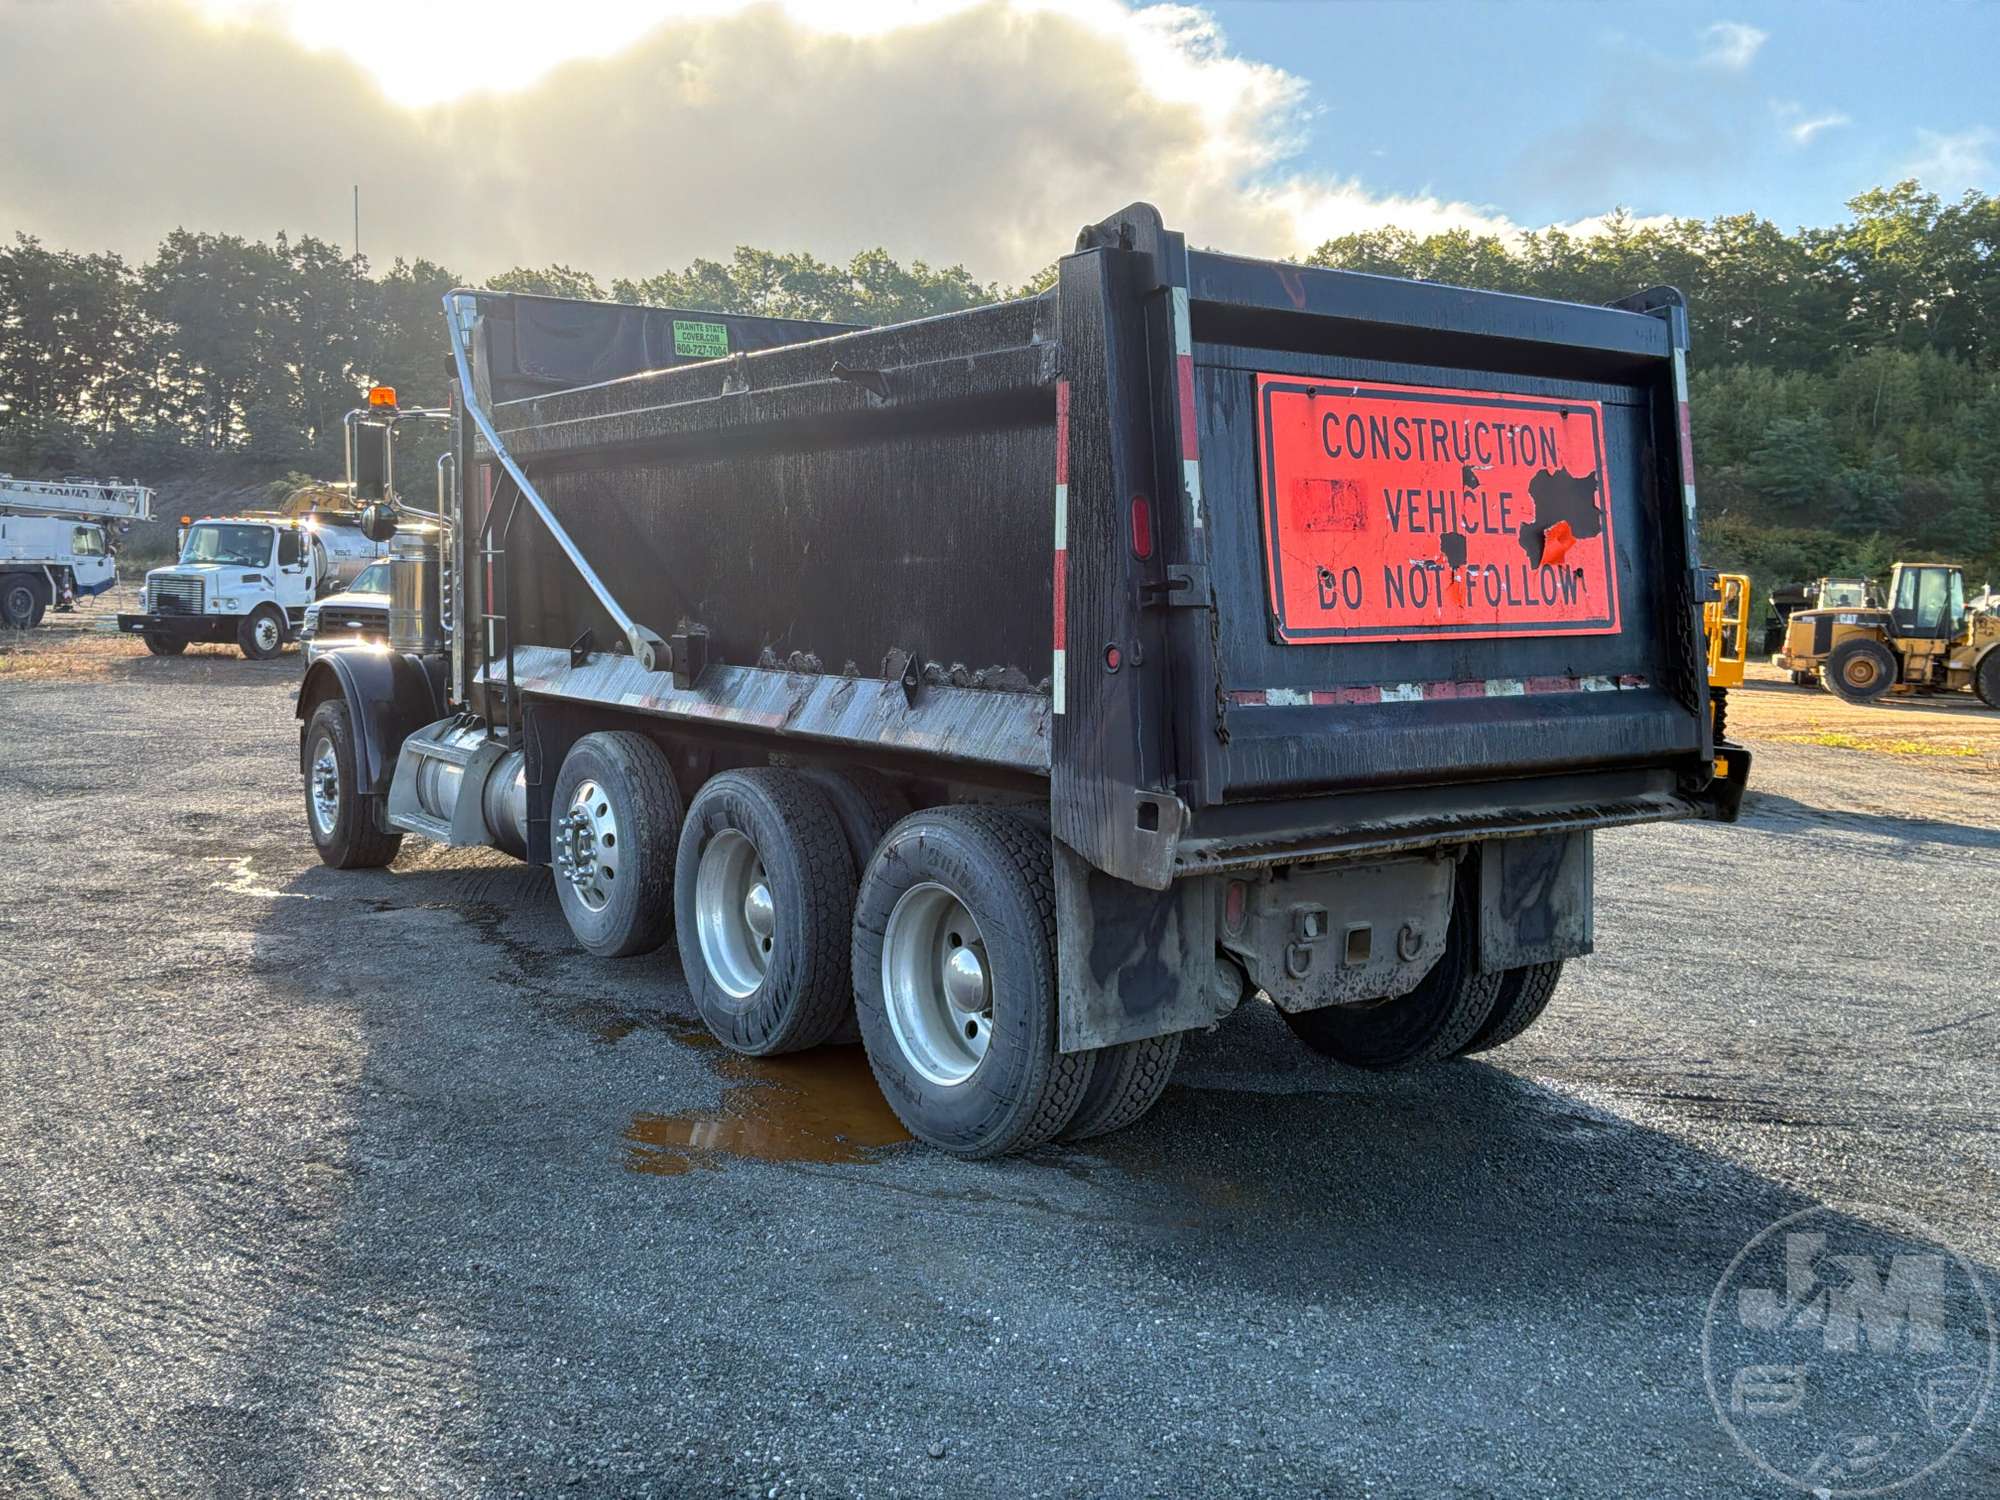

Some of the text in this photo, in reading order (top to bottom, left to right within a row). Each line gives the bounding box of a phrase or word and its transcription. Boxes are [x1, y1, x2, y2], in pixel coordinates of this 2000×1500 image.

[675, 322, 725, 334] GRANITE STATE
[683, 332, 720, 342] COVER.COM
[1322, 412, 1558, 467] CONSTRUCTION
[1384, 488, 1517, 534] VEHICLE
[1318, 564, 1578, 610] DO NOT FOLLOW
